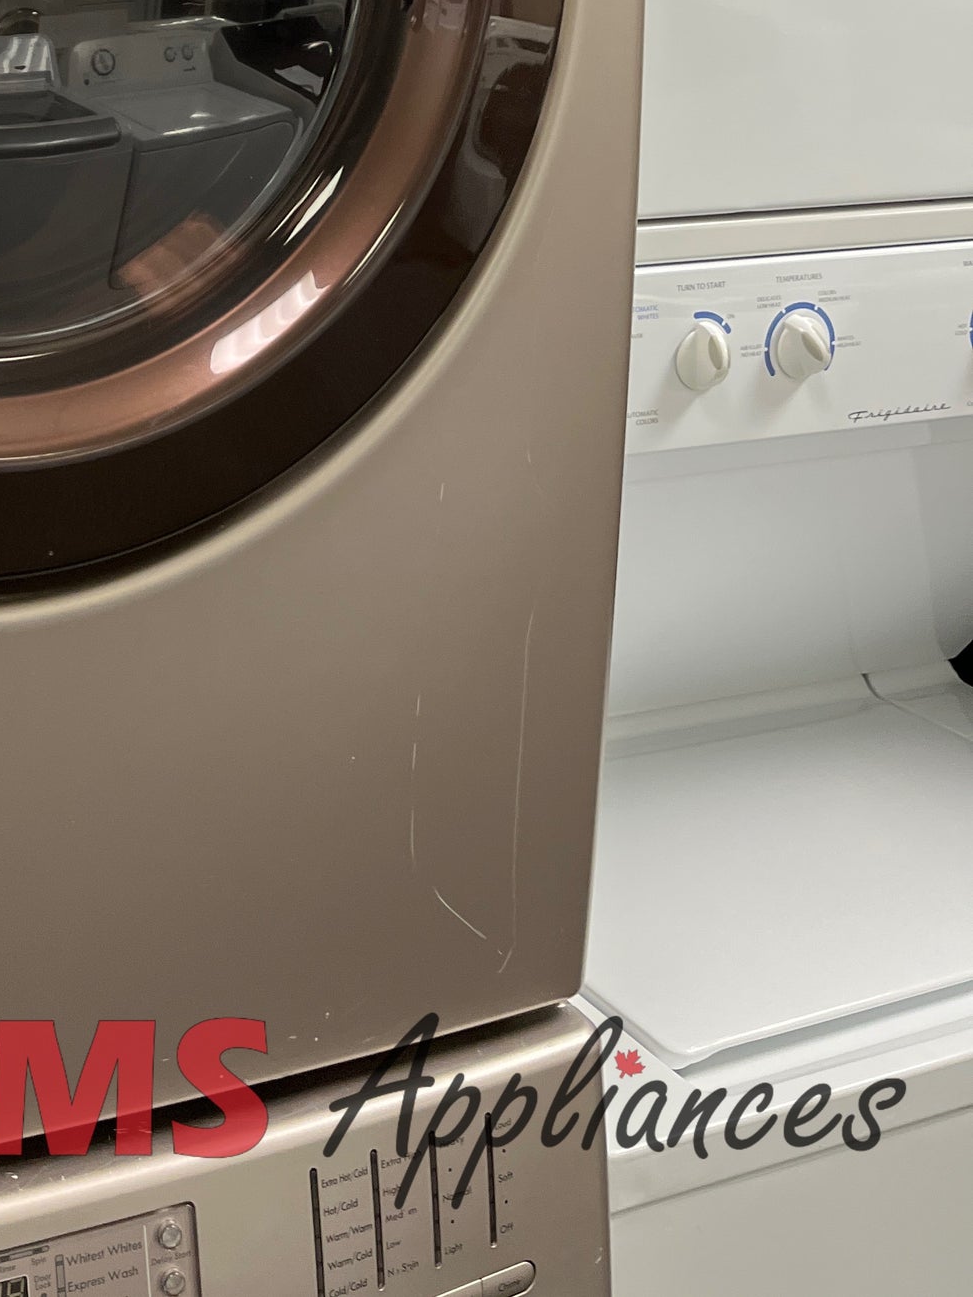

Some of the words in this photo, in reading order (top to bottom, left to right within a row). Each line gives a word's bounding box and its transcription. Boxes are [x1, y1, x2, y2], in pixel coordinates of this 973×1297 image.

[677, 284, 695, 292] TURN
[697, 282, 705, 290] TO
[707, 281, 726, 290] START
[775, 273, 823, 283] TEMPERATURES
[847, 403, 952, 423] Frigidaire
[381, 1157, 401, 1168] Extra
[321, 1178, 338, 1188] Extra
[339, 1167, 368, 1183] Hot/Cold
[498, 1171, 514, 1183] Soft
[324, 1198, 358, 1216] Hot/Cold
[326, 1223, 373, 1243] Warm/Warm
[500, 1222, 514, 1234] Off
[65, 1250, 104, 1267] Whitest
[107, 1240, 142, 1256] Whites
[386, 1240, 401, 1250] Low
[445, 1243, 463, 1255] Light
[328, 1248, 373, 1270] Warm/Cold
[67, 1276, 105, 1293] Express
[108, 1266, 139, 1281] Wash
[329, 1279, 368, 1297] Cold/Cold
